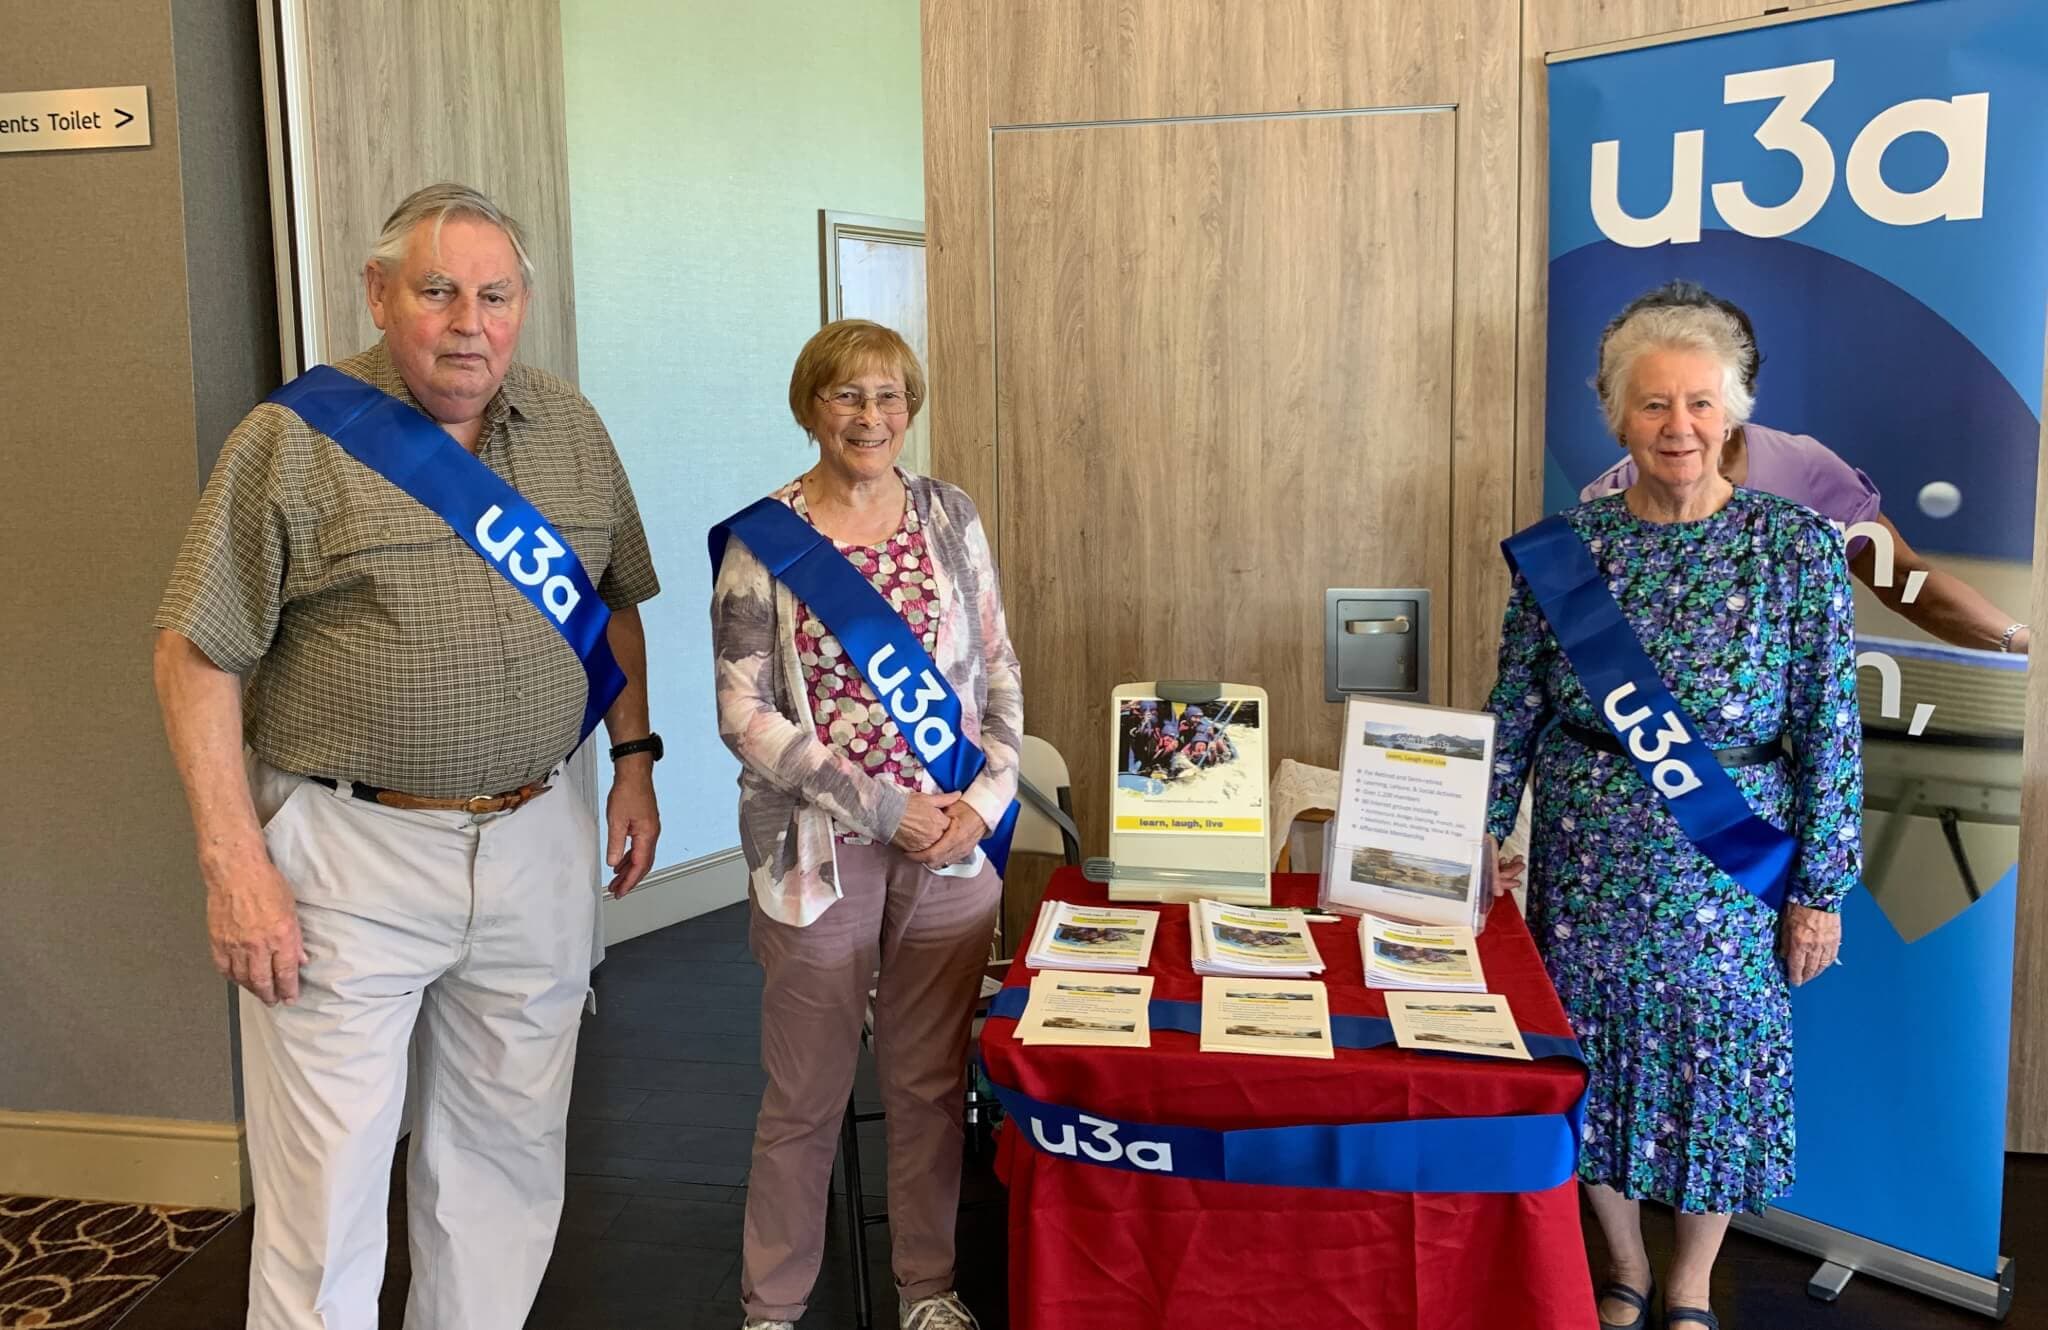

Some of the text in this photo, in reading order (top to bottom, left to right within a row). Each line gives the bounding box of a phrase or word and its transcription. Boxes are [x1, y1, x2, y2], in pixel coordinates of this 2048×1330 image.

[48, 110, 101, 131] Toilet
[1590, 59, 1989, 248] u3a
[475, 504, 581, 625] u3a
[868, 642, 957, 763] u3a
[1604, 681, 1703, 800] u3a
[1140, 818, 1224, 829] learn, laugh, live
[1030, 1114, 1173, 1172] u3a
